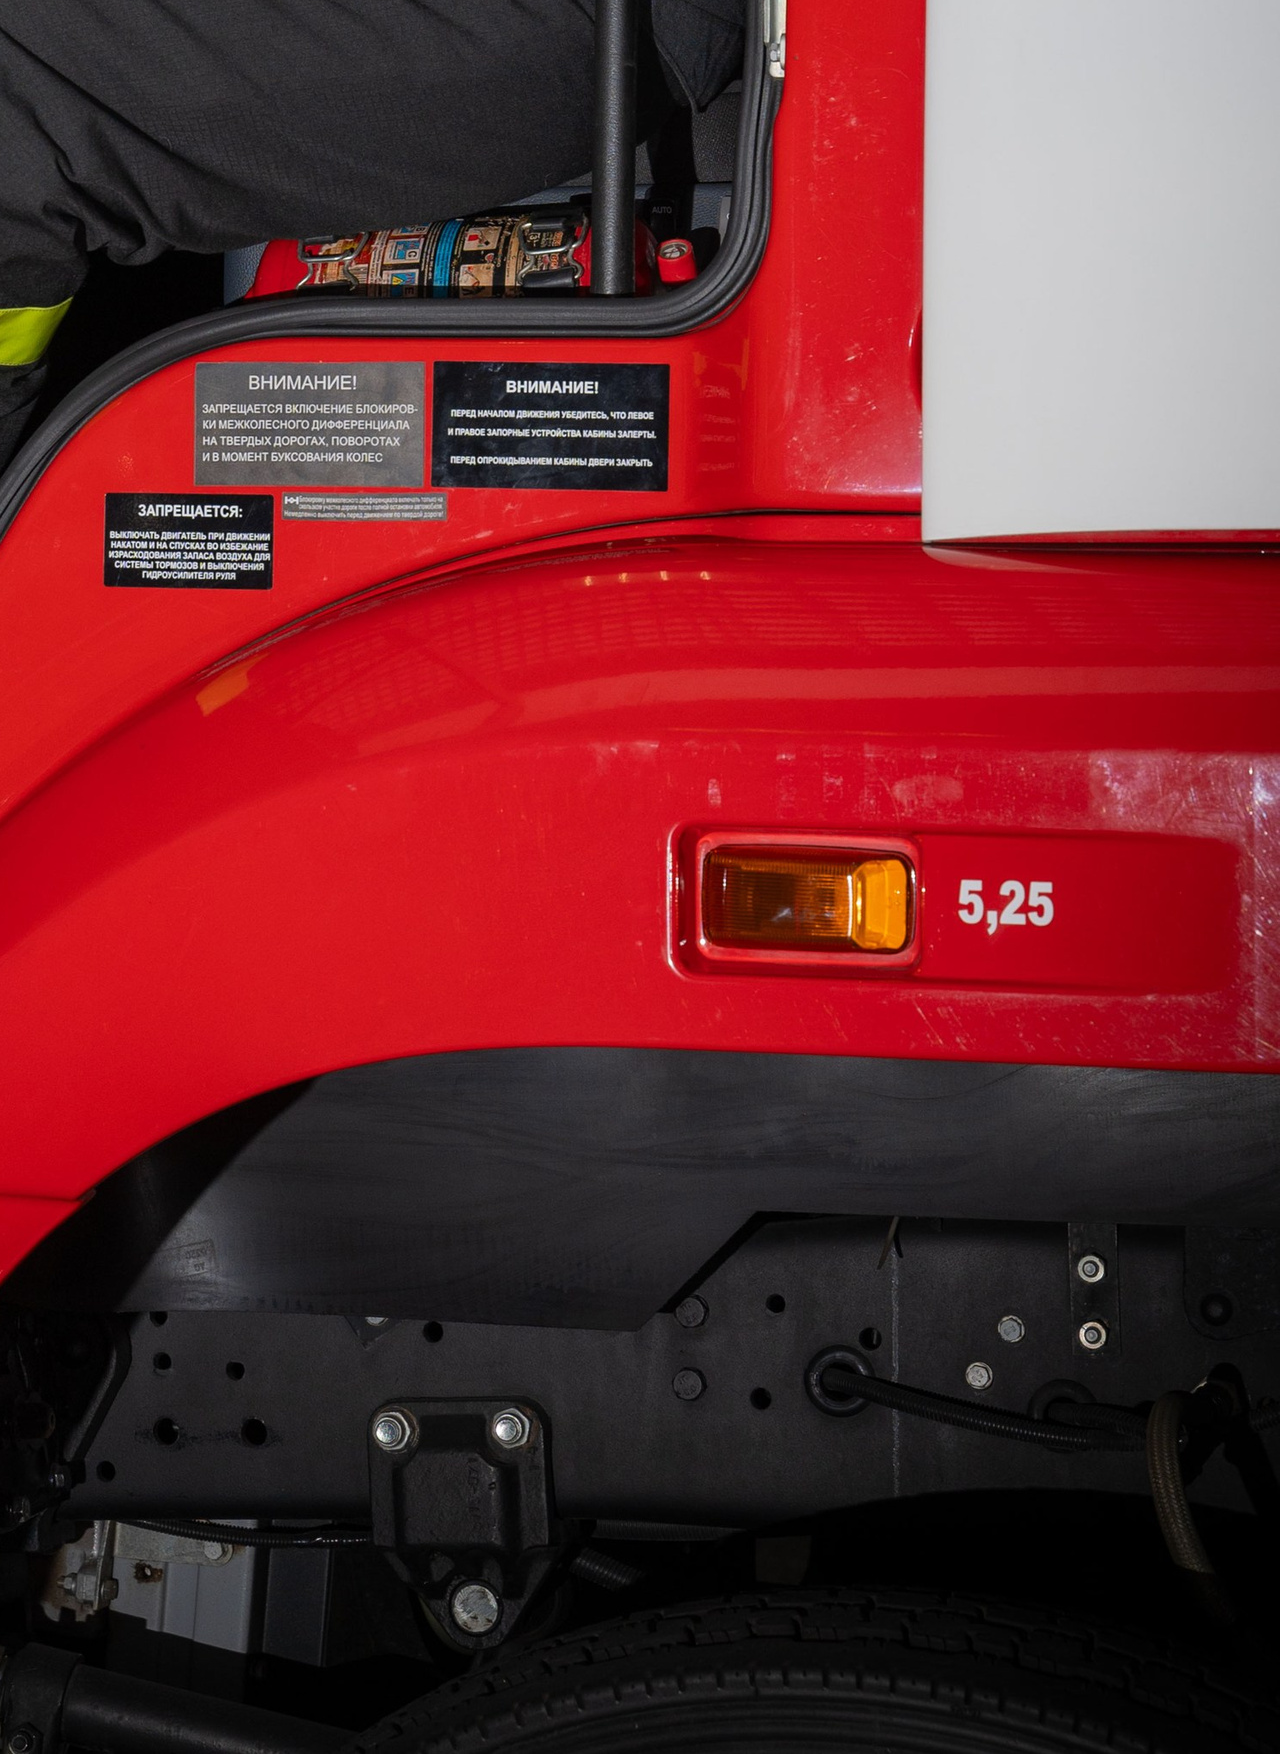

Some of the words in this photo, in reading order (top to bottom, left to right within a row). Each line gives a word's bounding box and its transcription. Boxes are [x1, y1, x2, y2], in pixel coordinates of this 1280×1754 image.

[652, 206, 672, 214] AUTO
[249, 375, 357, 390] ВНИМАНИЕ!
[506, 381, 598, 394] ВНИМАНИЕ!
[203, 404, 282, 415] ЗАПРЕЩАЕТСЯ
[286, 404, 353, 413] ВКЛЮЧЕНИЕ
[356, 404, 417, 414] БЛОКИРОВ-
[451, 409, 476, 418] ПЕРЕД
[517, 410, 559, 419] ДВИЖЕНИЯ
[561, 411, 609, 419] УБЕДИТЕСЬ,
[203, 420, 216, 429] КИ
[219, 420, 309, 430] МЕЖКОЛЕСНОГО
[312, 420, 409, 431] ДИФФЕРЕНЦИАЛА
[455, 428, 485, 436] ПРАВОЕ
[487, 429, 530, 437] ЗАПОРНЫЕ
[531, 428, 581, 437] УСТРОЙСТВА
[583, 430, 616, 438] КАБИНЫ
[618, 430, 656, 438] ЗАПЕРТЫ.
[203, 436, 217, 445] НА
[220, 436, 271, 447] ТВЕРДЫХ
[274, 436, 328, 447] ДОРОГАХ,
[332, 437, 399, 446] ПОВОРОТАХ
[203, 453, 210, 461] И
[213, 452, 219, 461] В
[222, 452, 268, 461] МОМЕНТ
[271, 452, 343, 461] БУКСОВАНИЯ
[347, 453, 383, 462] КОЛЕС
[451, 456, 476, 465] ПЕРЕД
[478, 457, 552, 465] ОПРОКИДЫВАНИЕМ
[588, 458, 614, 467] ДВЕРИ
[616, 459, 653, 467] ЗАКРЫТЬ
[138, 504, 242, 519] ЗАПРЕЩАЕТСЯ:
[110, 531, 159, 539] ВЫКЛЮЧАТЬ
[161, 532, 206, 540] ДВИГАТЕЛЬ
[209, 532, 224, 540] ПРИ
[226, 533, 270, 541] ДВИЖЕНИИ
[207, 542, 218, 550] ВО
[220, 543, 268, 551] ИЗБЕЖАНИЕ
[109, 551, 180, 559] ИЗРАСХОДОВАНИЯ
[216, 552, 252, 561] ВОЗДУХА
[254, 553, 270, 561] ДЛЯ
[156, 561, 198, 569] ТОРМОЗОВ
[208, 562, 264, 570] ВЫКЛЮЧЕНИЯ
[142, 571, 213, 579] ГИДРОУСИЛИТЕЛЯ
[216, 572, 236, 580] РУЛЯ
[958, 879, 1054, 936] 5,25
